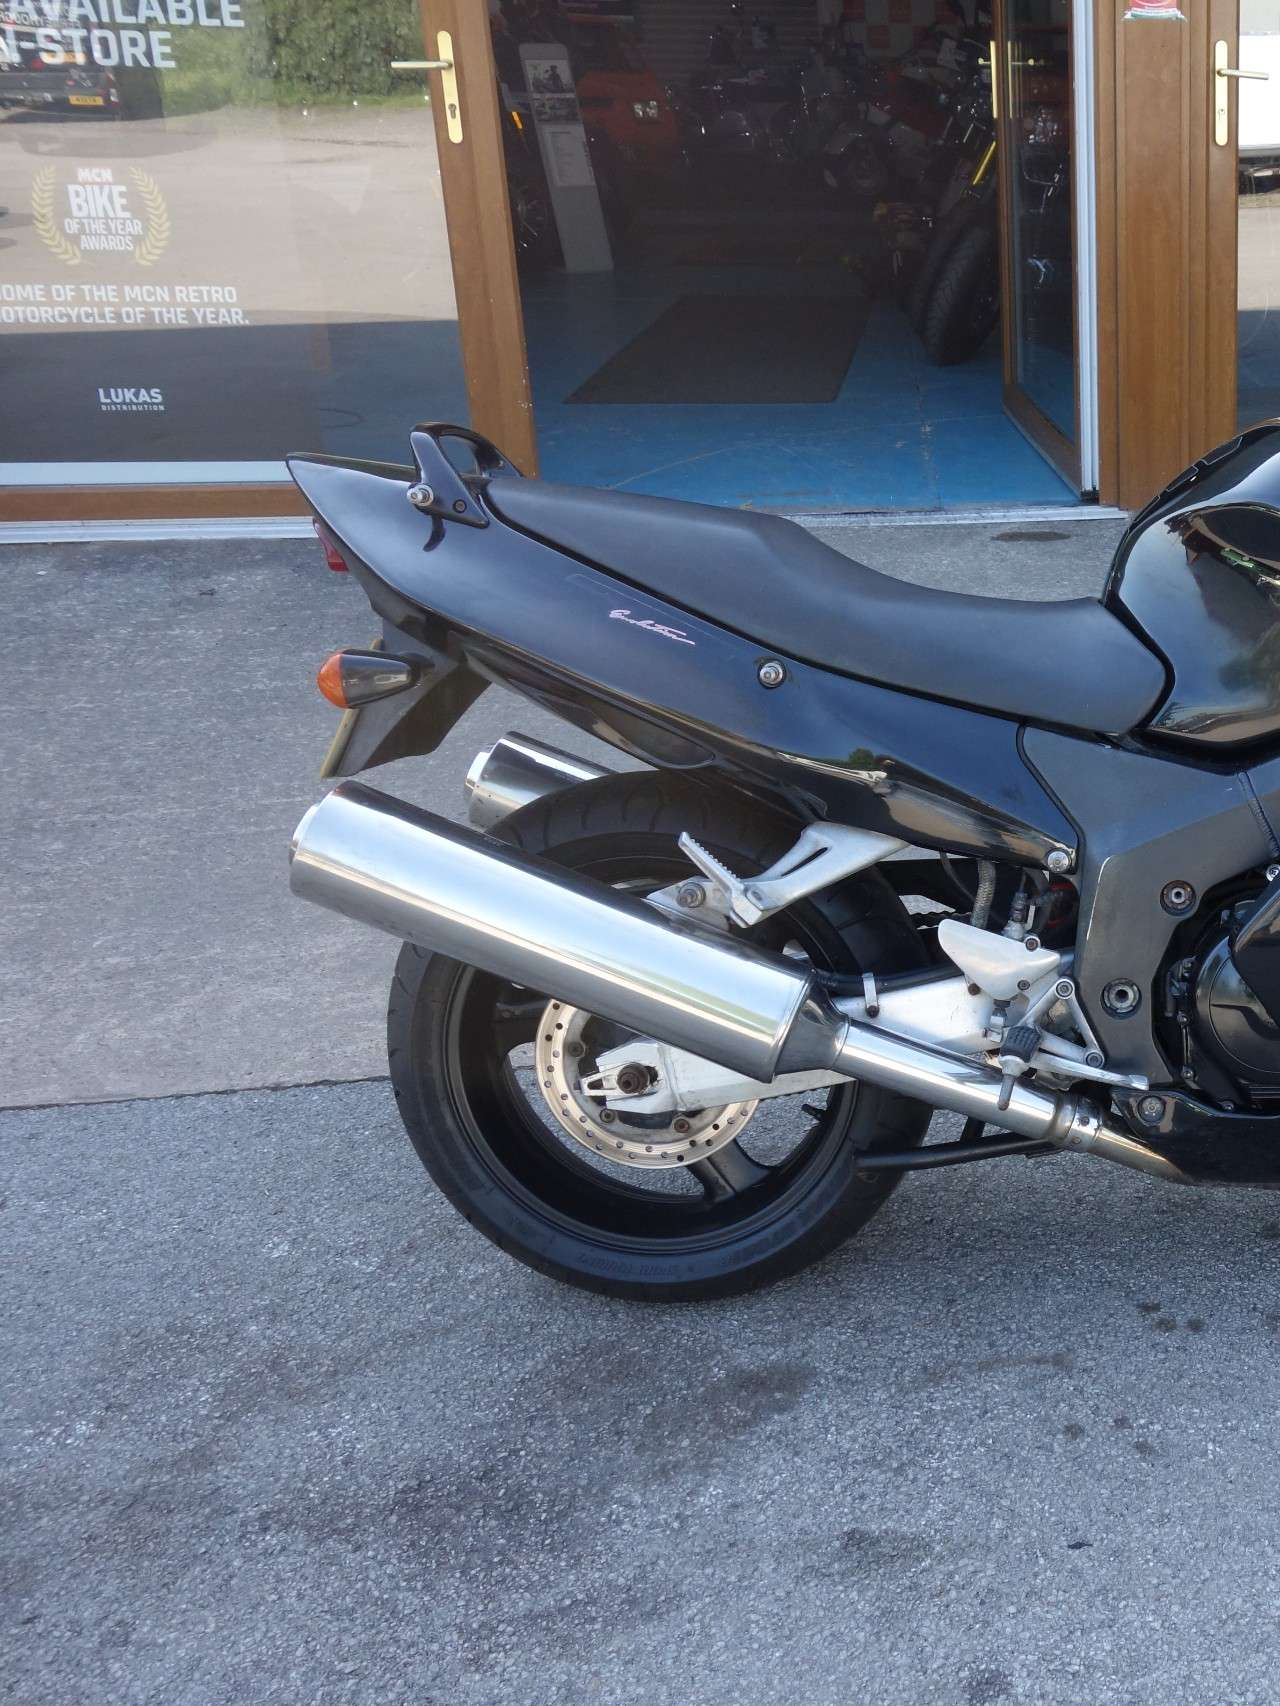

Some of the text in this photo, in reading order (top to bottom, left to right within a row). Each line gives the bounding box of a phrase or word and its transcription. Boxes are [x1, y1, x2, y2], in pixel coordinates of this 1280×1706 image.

[9, 0, 244, 27] AVAILABLE
[78, 168, 112, 182] MCN
[67, 184, 131, 218] BIKE
[64, 218, 143, 235] OF THE YEAR
[80, 236, 133, 250] AWARDS
[0, 284, 237, 303] OME OF THE MCN RETRO
[0, 306, 249, 325] OTORCYCLE OF THE YEAR.
[98, 388, 163, 403] LUKAS
